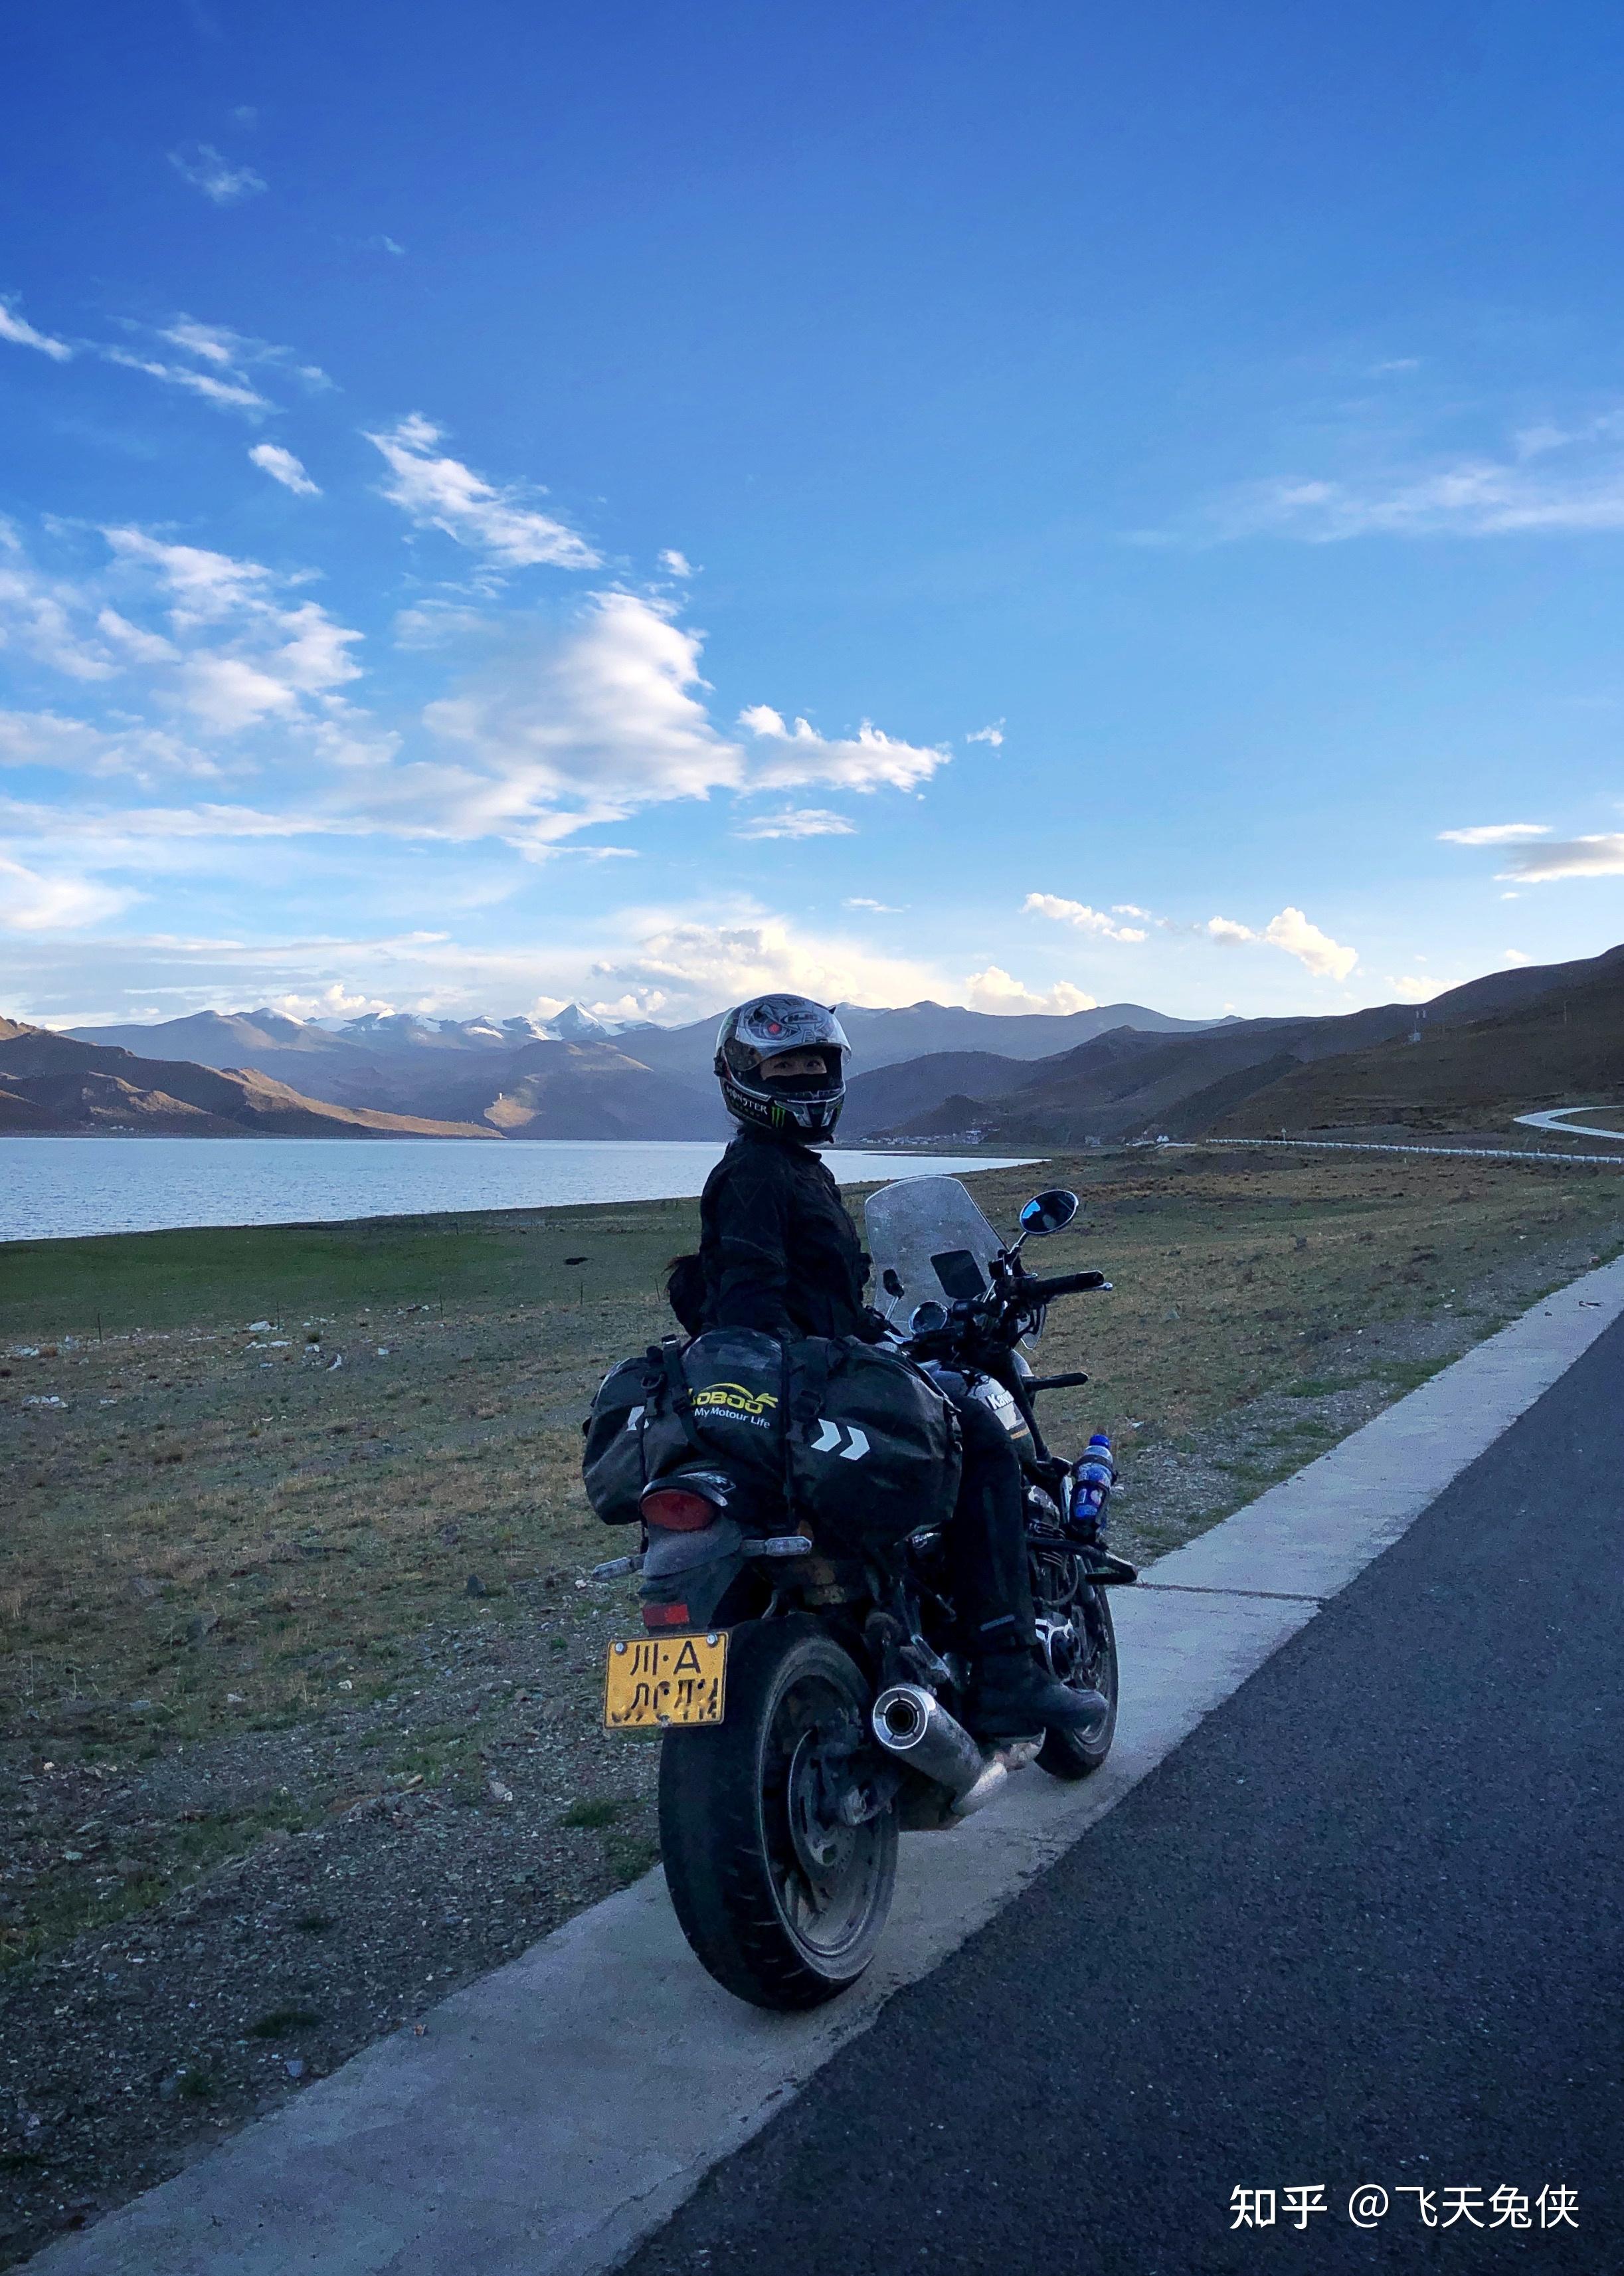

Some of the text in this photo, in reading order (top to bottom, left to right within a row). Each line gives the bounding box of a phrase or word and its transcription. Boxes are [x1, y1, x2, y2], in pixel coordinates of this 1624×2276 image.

[726, 1085, 768, 1115] MONSTER
[689, 1390, 763, 1414] OBOO
[694, 1407, 770, 1429] My Motour Life
